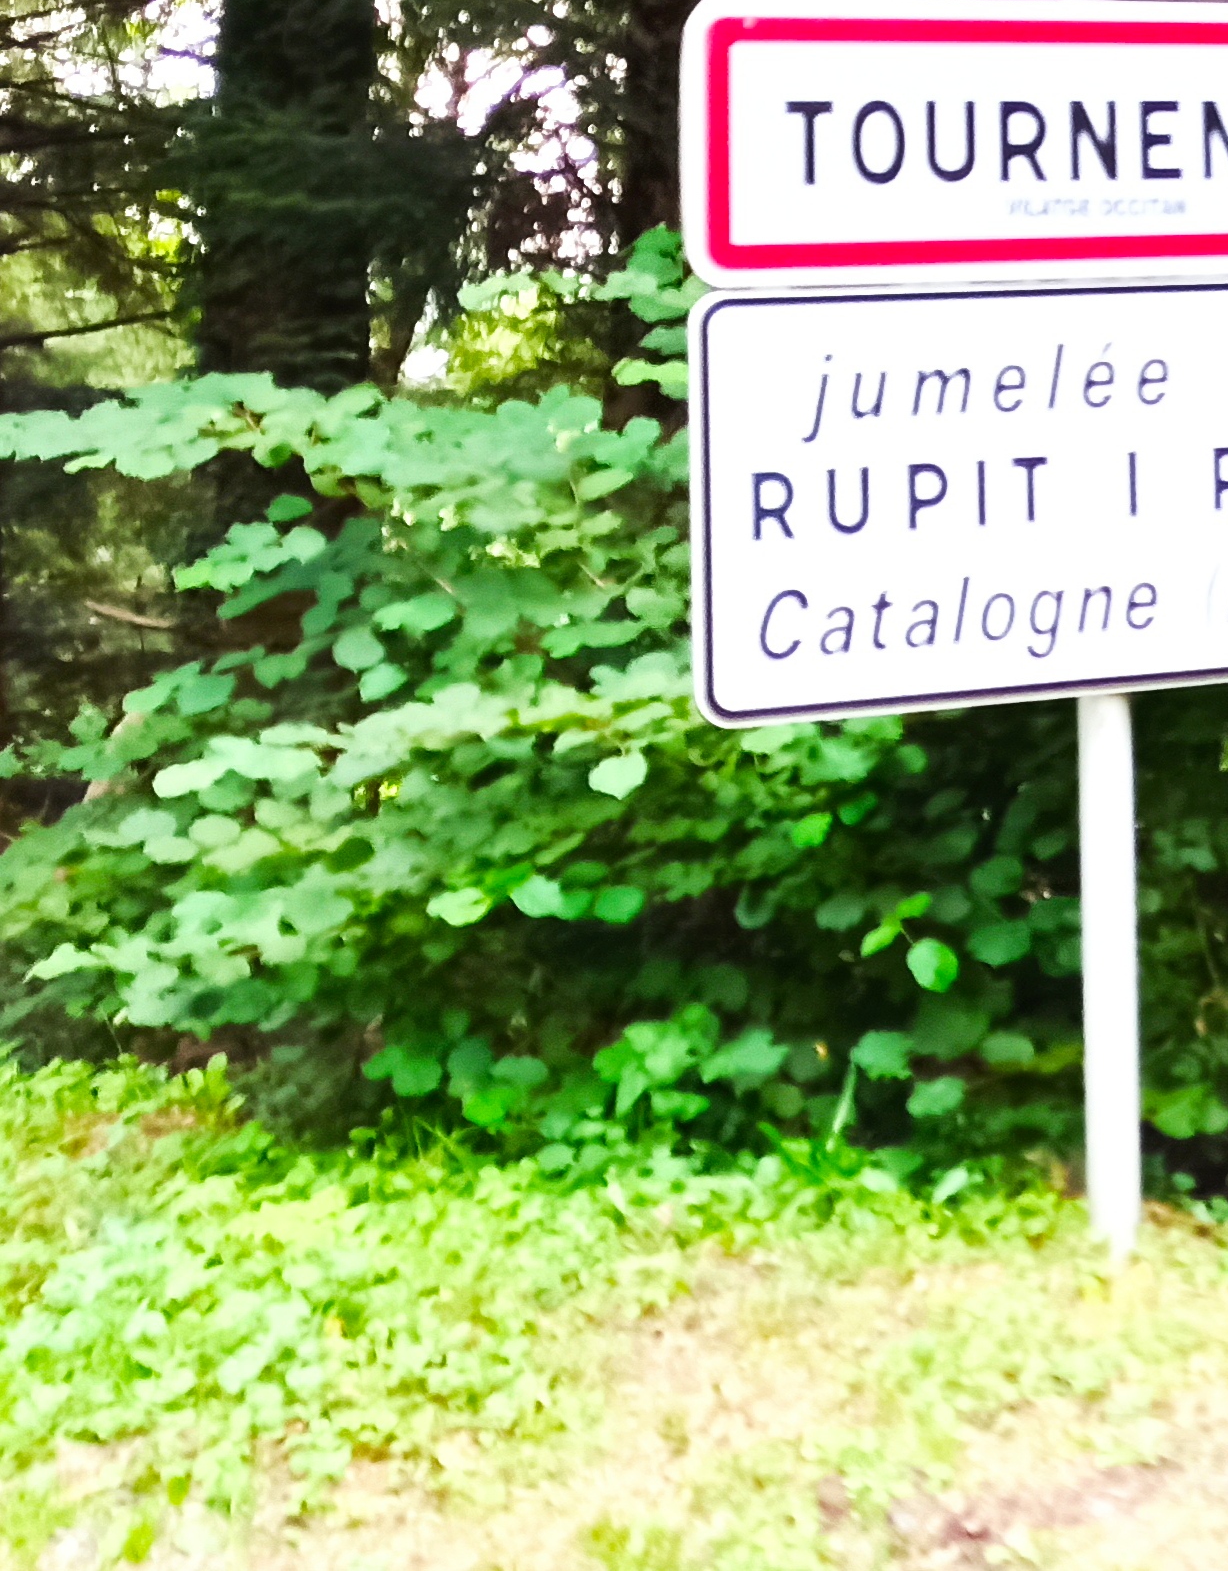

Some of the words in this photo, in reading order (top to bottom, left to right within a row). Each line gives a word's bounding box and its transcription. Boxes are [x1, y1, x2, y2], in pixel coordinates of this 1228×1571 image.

[801, 342, 1170, 444] jumelée
[751, 455, 1049, 542] RUPIT
[1126, 450, 1139, 518] I
[758, 575, 1159, 662] Catalogne
